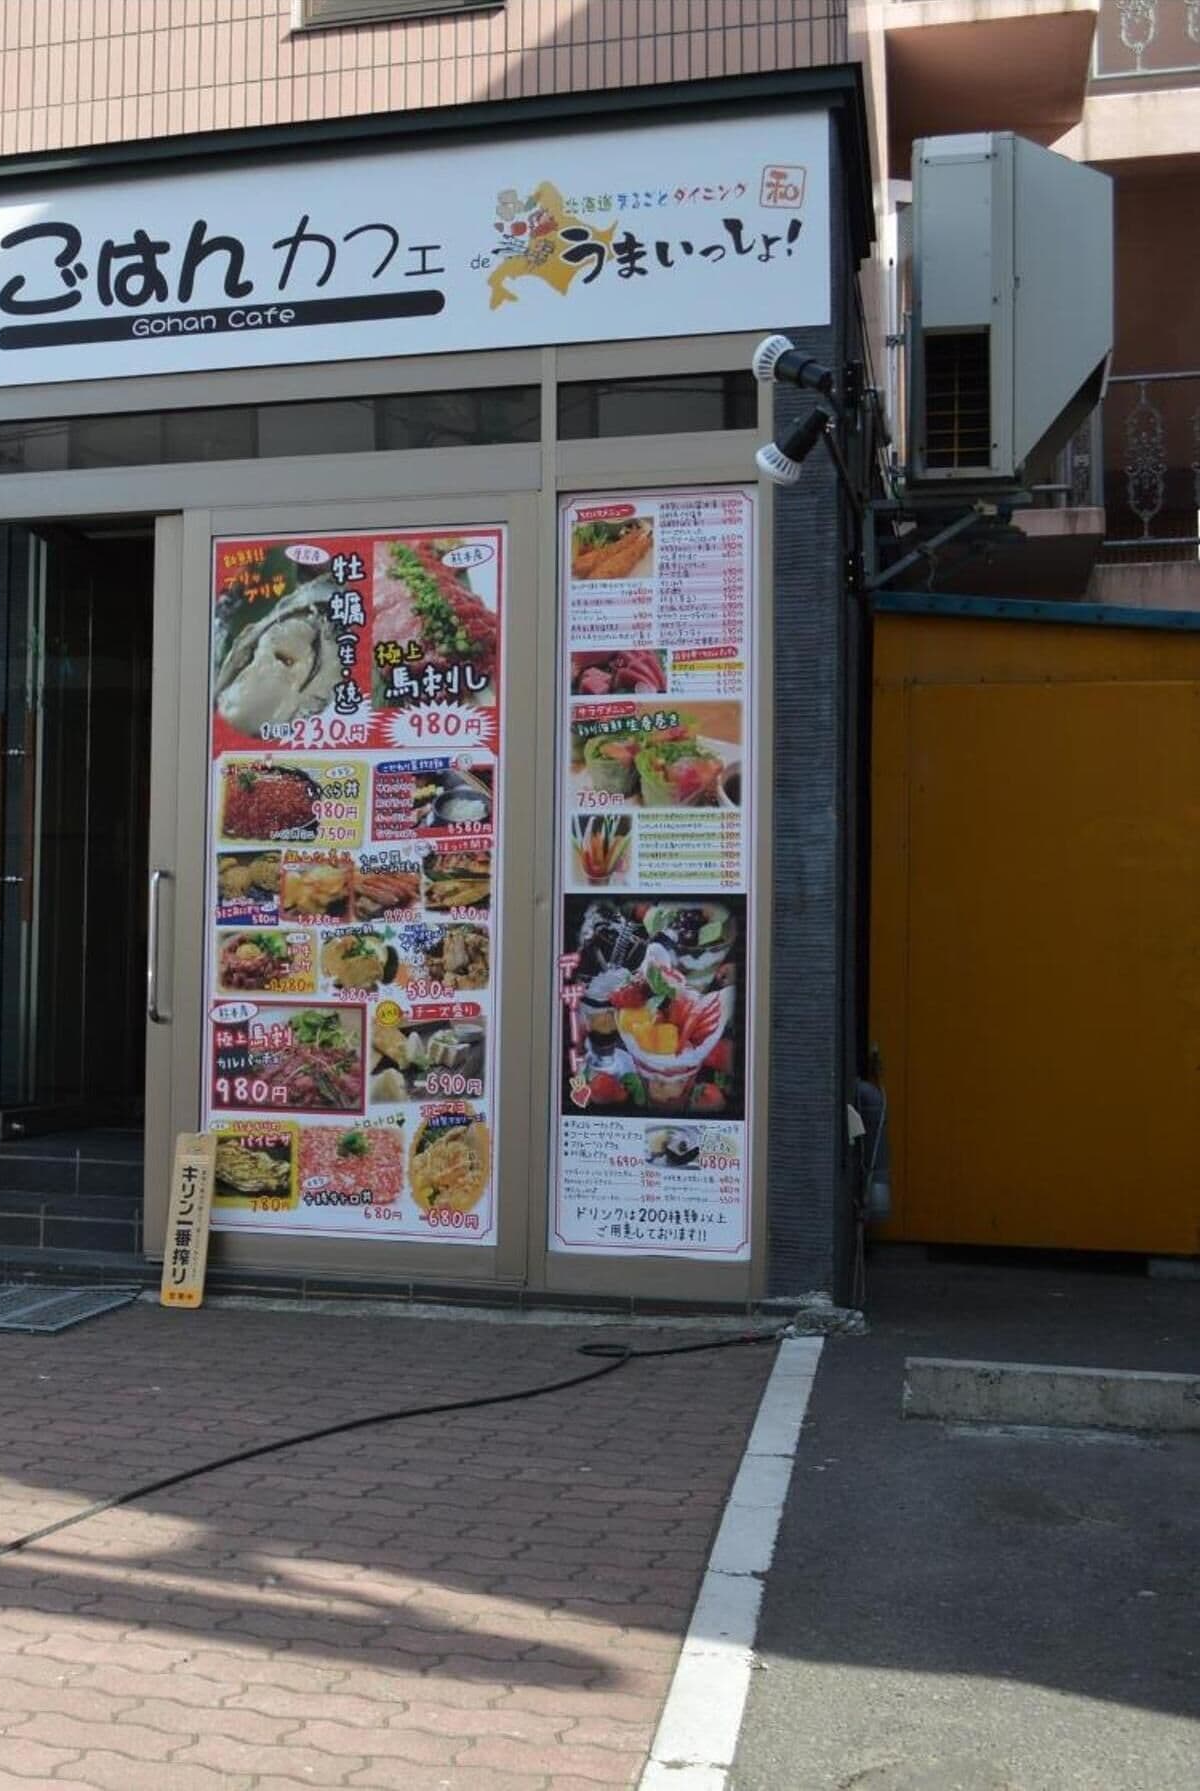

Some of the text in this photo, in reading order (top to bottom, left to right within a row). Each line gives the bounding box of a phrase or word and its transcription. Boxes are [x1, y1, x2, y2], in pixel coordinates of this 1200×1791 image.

[558, 217, 803, 284] うまいっしょ!
[469, 256, 491, 270] de
[131, 303, 296, 337] Gohan Cafe
[376, 642, 424, 667] 極上
[386, 663, 488, 699] 馬刺し
[293, 721, 368, 743] 230円
[409, 712, 483, 738] 980円
[311, 800, 359, 821] 980円
[576, 791, 625, 808] 750円
[559, 953, 585, 1074] デザート
[215, 1077, 288, 1104] 980円
[425, 1073, 483, 1096] 690円
[171, 1165, 200, 1285] キリン一番搾り
[363, 1206, 402, 1221] 680円
[426, 1211, 480, 1231] 680円
[576, 1207, 729, 1226] ドリンクは200種類以上
